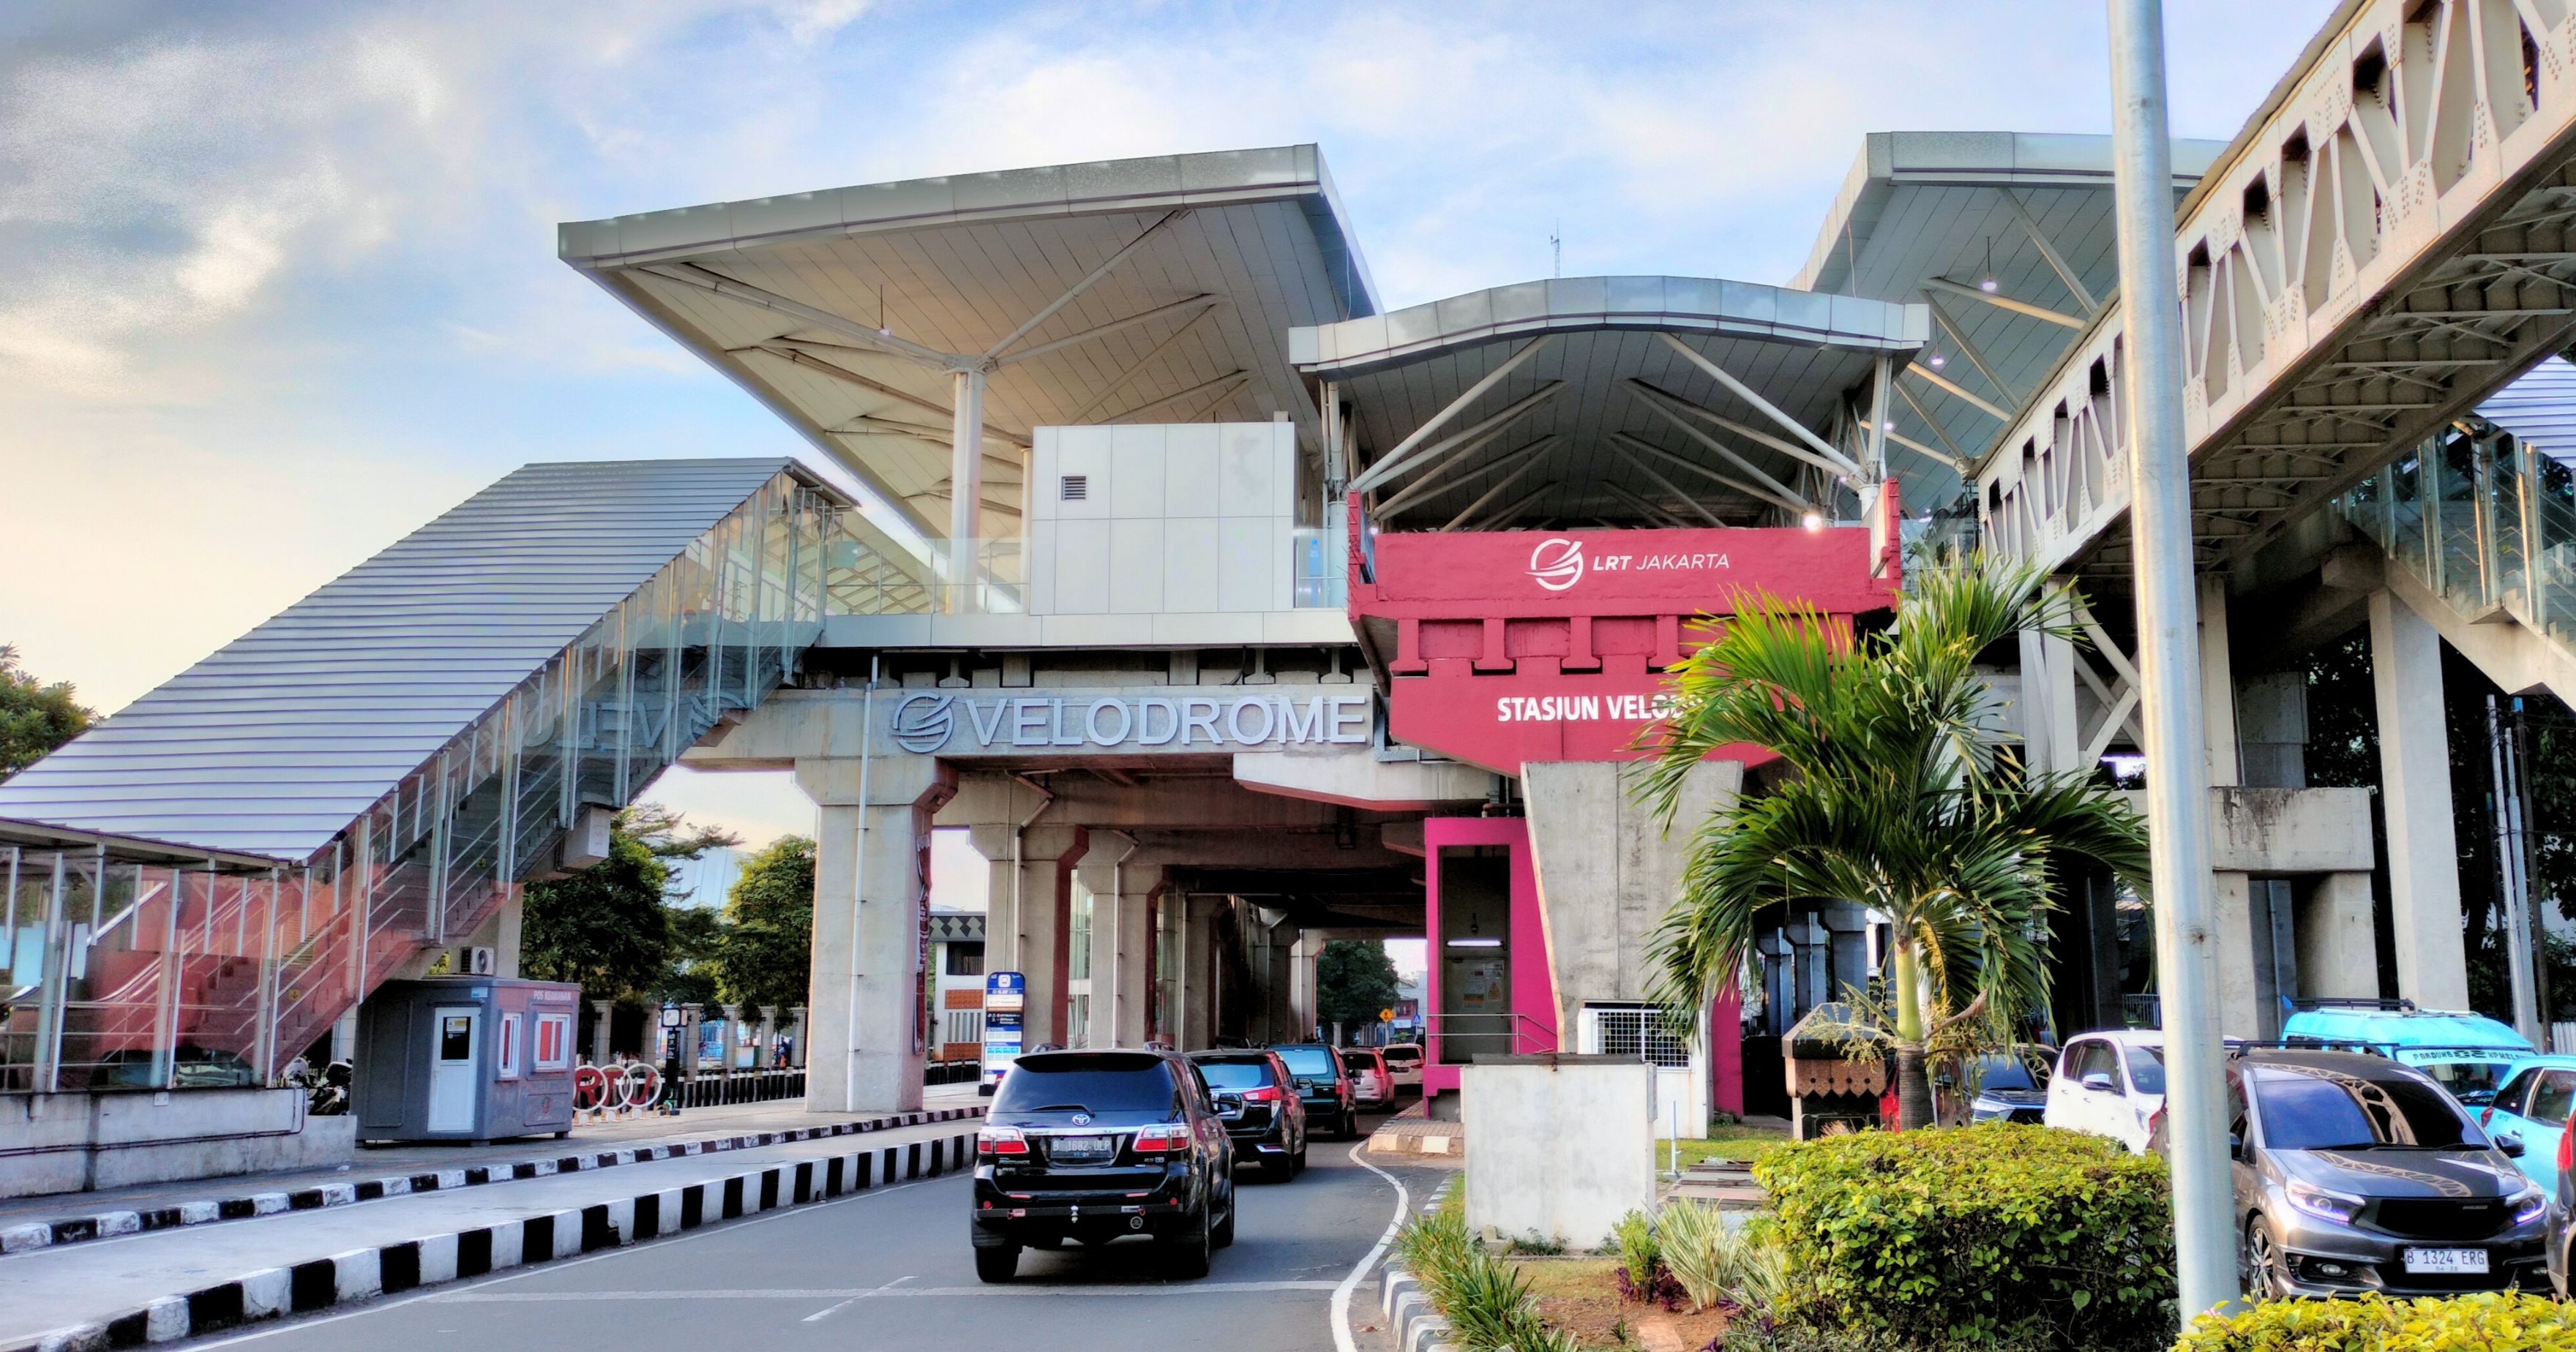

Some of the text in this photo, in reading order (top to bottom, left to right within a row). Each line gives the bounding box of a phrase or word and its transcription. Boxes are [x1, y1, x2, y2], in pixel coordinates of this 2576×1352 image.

[1592, 552, 1730, 571] LRT JAKARTA
[1497, 696, 1599, 722] STASIUN
[966, 696, 1366, 746] VELODROME
[533, 990, 544, 1000] POS
[1053, 1140, 1110, 1152] B 1682 ULP
[2407, 1250, 2485, 1265] B 1324 ERG
